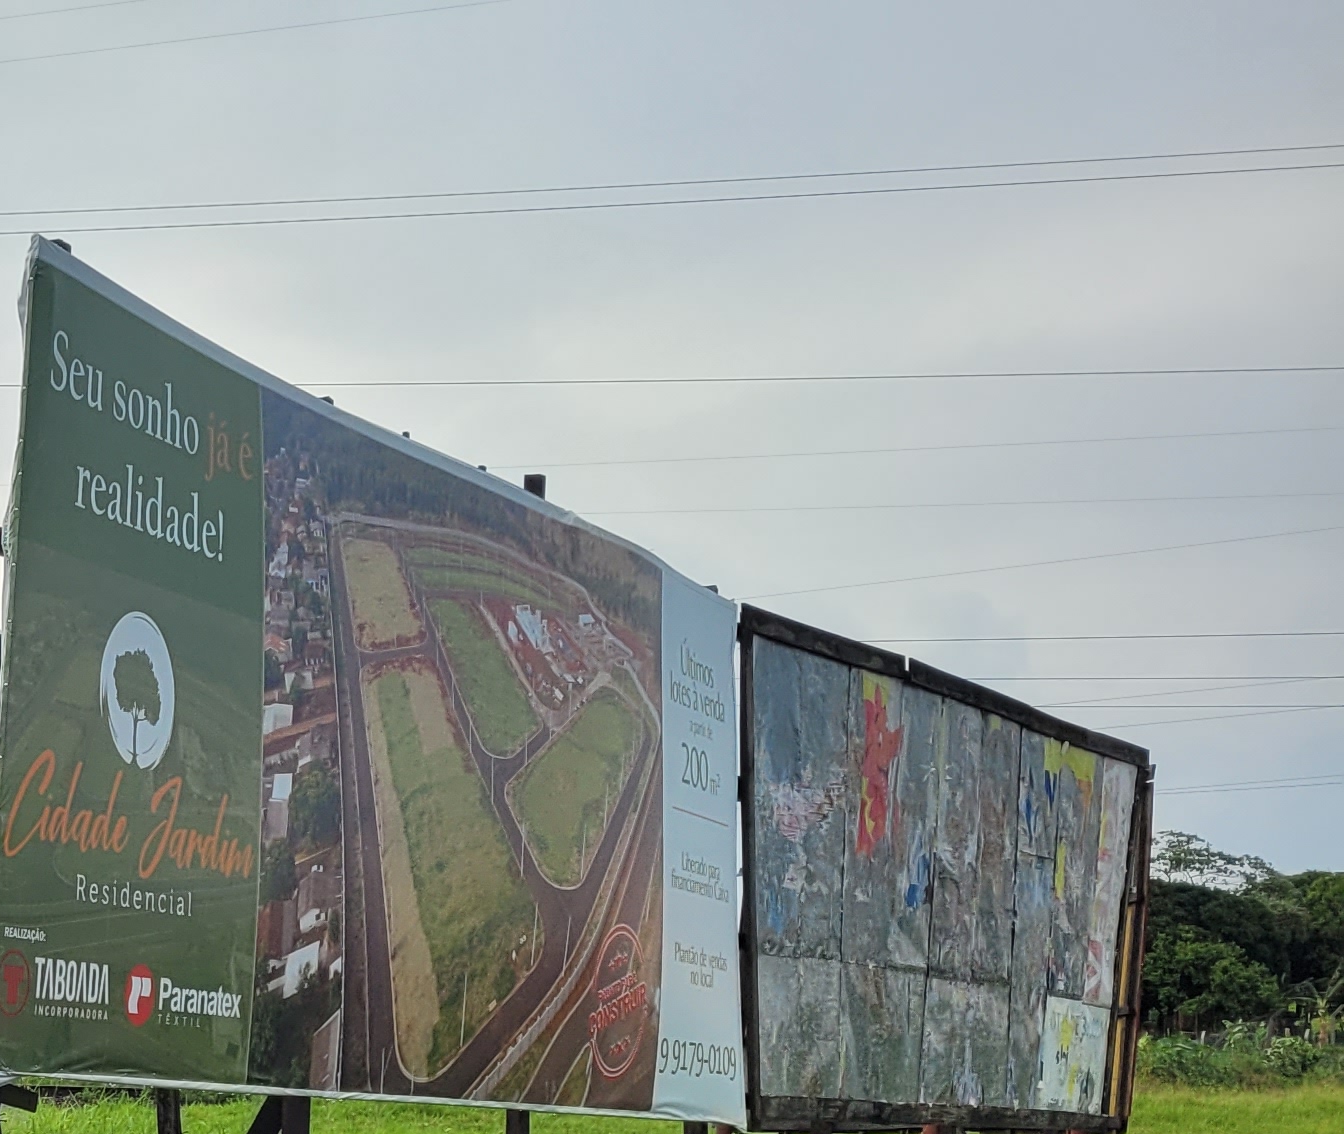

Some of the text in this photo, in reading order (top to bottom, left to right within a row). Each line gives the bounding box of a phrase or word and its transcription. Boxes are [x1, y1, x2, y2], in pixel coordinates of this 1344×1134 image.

[50, 330, 254, 482] Seu sonho já é
[74, 463, 224, 562] realidade!
[680, 637, 714, 689] Últimos
[670, 670, 692, 708] lotes
[699, 691, 725, 722] venda
[681, 742, 709, 792] 200
[2, 748, 129, 857] Cidade
[138, 776, 254, 880] Jardim
[76, 873, 193, 917] Residencial
[3, 926, 47, 943] REALIZAÇÃO:
[674, 942, 699, 966] Plantão
[34, 957, 110, 1005] TABOADA
[158, 978, 242, 1019] Paranatex
[690, 971, 699, 986] no
[33, 1004, 109, 1021] INCORPORADORA
[157, 1013, 201, 1029] TÊXTIL
[658, 1037, 737, 1082] 9 9179-0109
